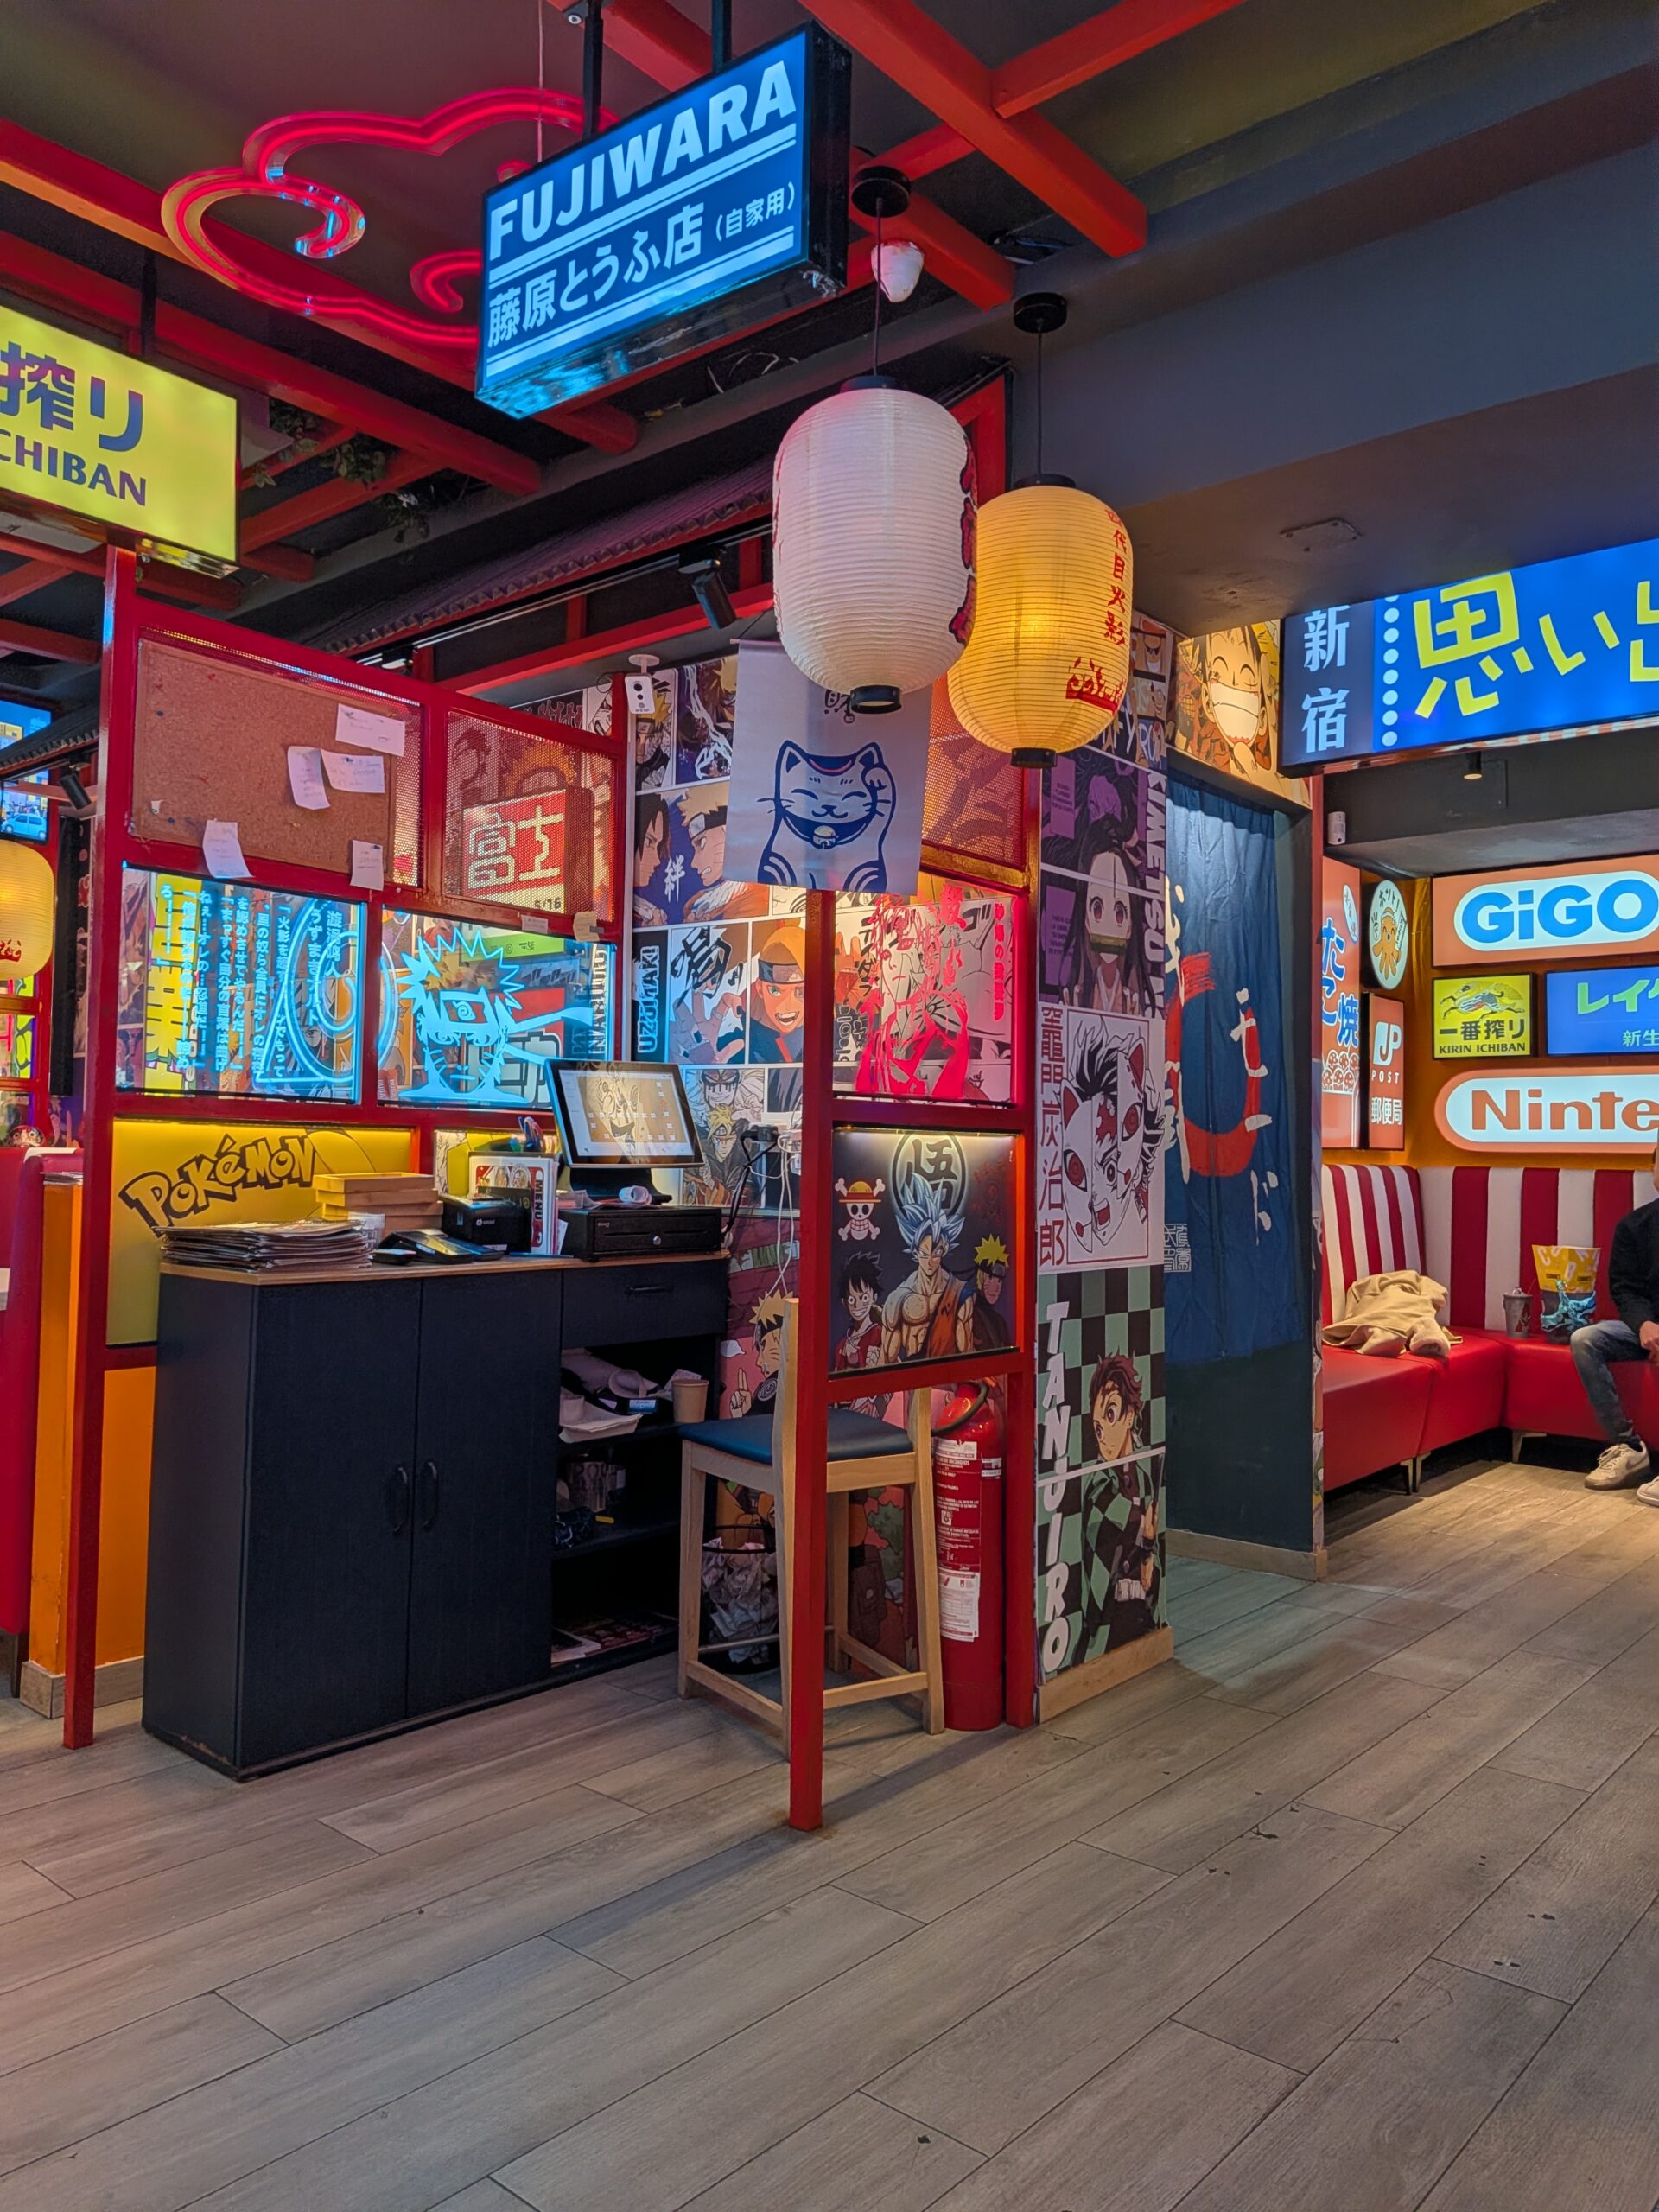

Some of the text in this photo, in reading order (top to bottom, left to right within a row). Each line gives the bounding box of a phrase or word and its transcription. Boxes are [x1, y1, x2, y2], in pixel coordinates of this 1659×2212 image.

[489, 60, 797, 261] FUJIWARA
[487, 202, 704, 349] 藤原とうふ店
[1302, 605, 1351, 753] 新宿
[664, 855, 685, 904] 絆
[1144, 771, 1166, 963] KIMETSU
[1461, 879, 1659, 944] GiGO
[1439, 1018, 1526, 1041] 一番搾り
[1439, 1042, 1526, 1055] KIRIN ICHIBAN
[1370, 1070, 1401, 1084] POST
[1370, 1097, 1403, 1126] 郵便局
[534, 1179, 543, 1220] MENU
[905, 1138, 961, 1210] 悟
[1042, 1301, 1071, 1673] TANJIRO
